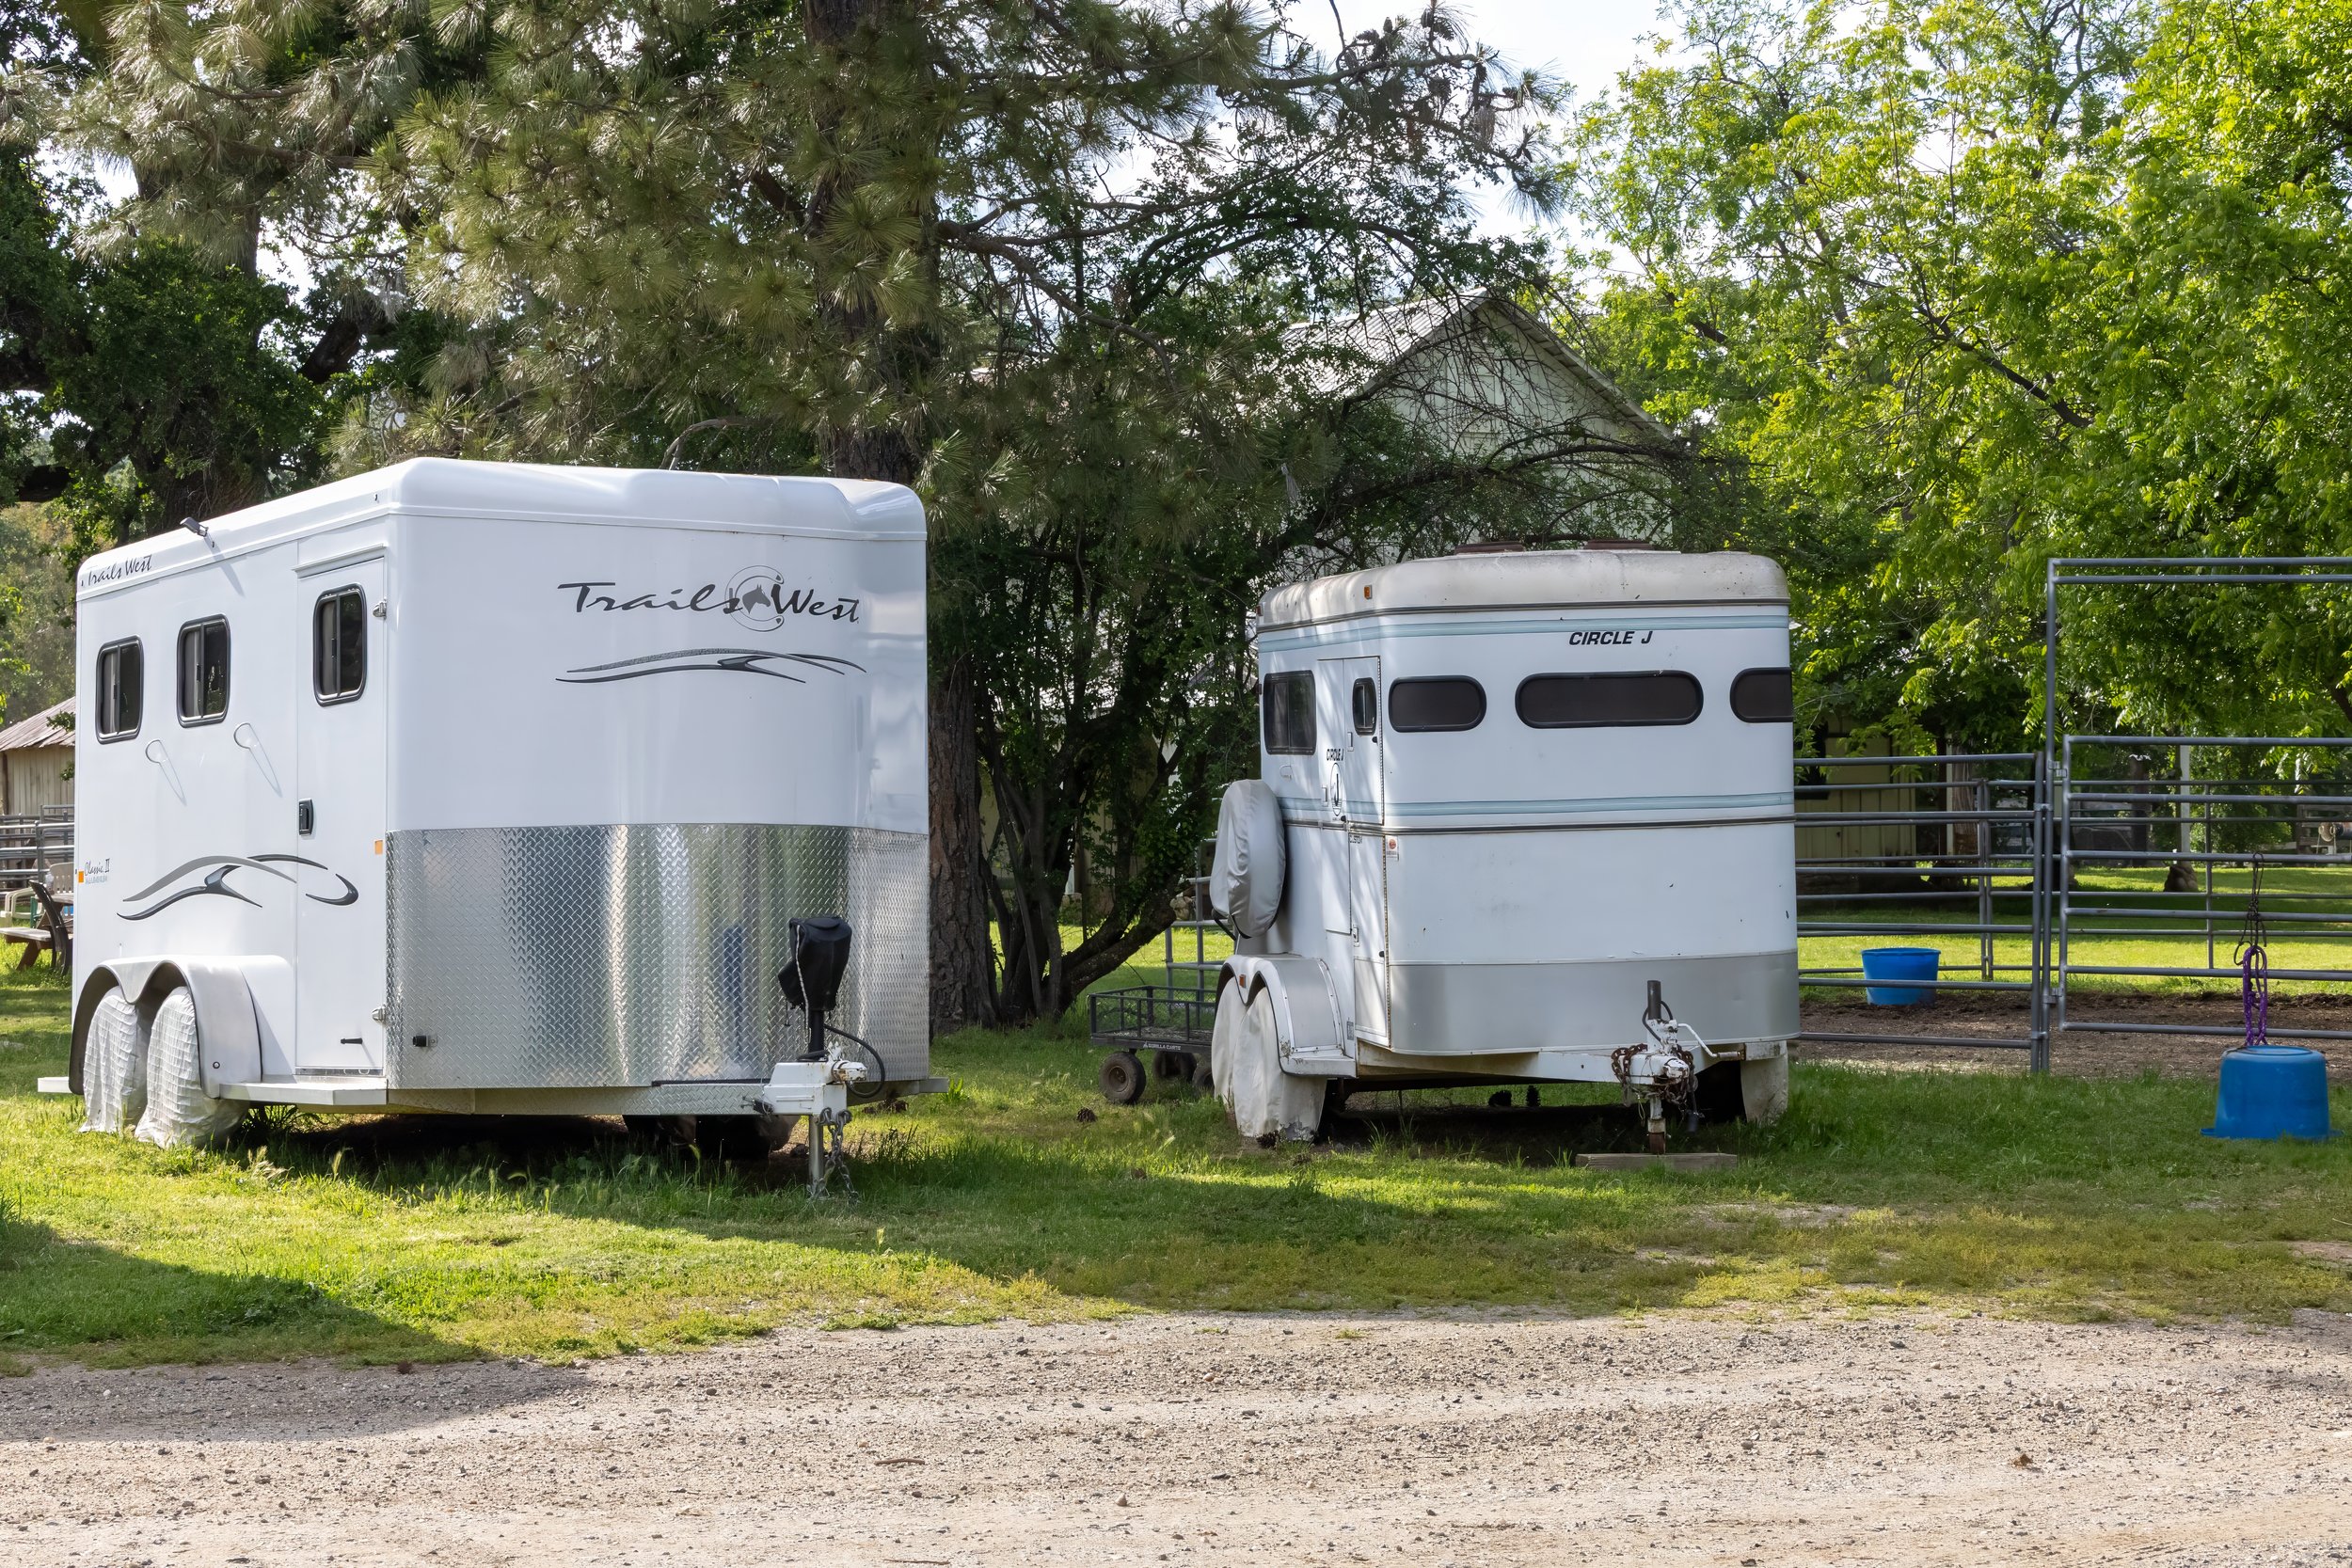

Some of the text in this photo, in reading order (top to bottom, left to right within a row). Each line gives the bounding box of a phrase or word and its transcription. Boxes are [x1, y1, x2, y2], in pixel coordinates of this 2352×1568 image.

[87, 554, 152, 586] Trails West
[557, 581, 860, 624] Trails West
[1569, 630, 1653, 645] CIRCLE J
